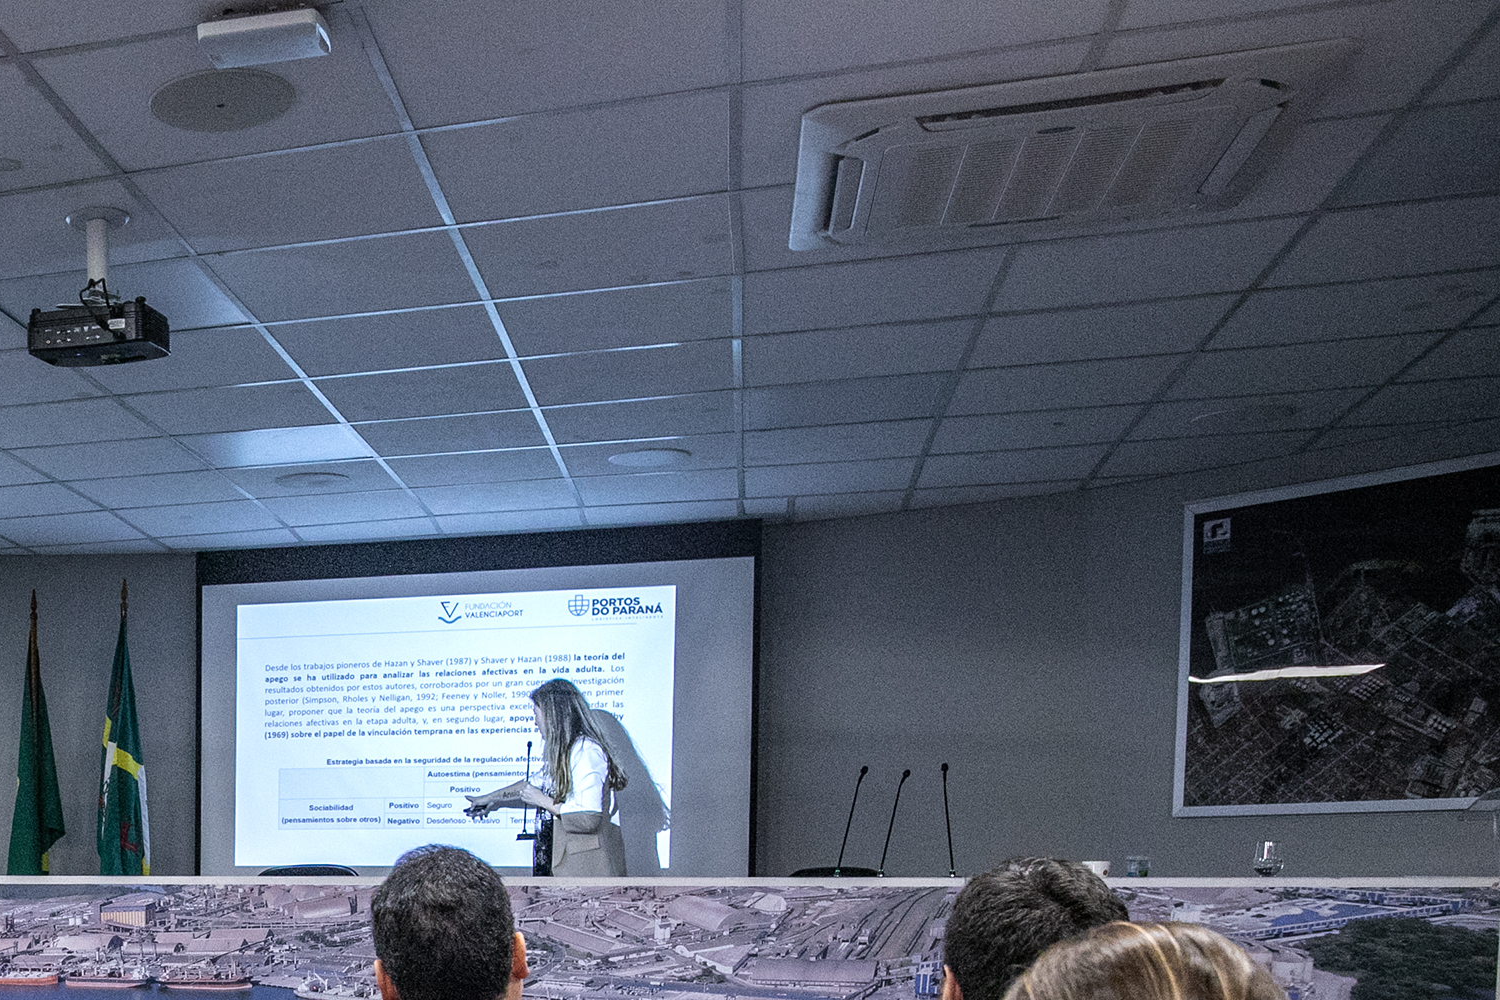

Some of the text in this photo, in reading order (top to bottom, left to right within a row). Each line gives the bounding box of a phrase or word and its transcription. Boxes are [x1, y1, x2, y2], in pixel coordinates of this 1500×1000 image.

[465, 601, 512, 610] FUNDACIÓN
[592, 597, 640, 606] PORTOS
[465, 610, 524, 618] VALENCIAPORT
[592, 602, 663, 616] DO PARANÁ
[265, 664, 288, 672] Desde
[304, 662, 334, 672] trabajos
[336, 661, 370, 671] pioneros
[384, 660, 408, 668] Hazan
[446, 657, 471, 666] (1987)
[481, 657, 507, 665] Shaver
[584, 653, 609, 661] teoría
[612, 652, 625, 660] del
[360, 674, 378, 682] para
[436, 669, 476, 677] relaciones
[482, 668, 518, 676] afectivas
[575, 665, 605, 673] adulta.
[265, 686, 304, 694] resultados
[306, 685, 344, 693] obtenidos
[385, 683, 417, 691] autores,
[420, 681, 473, 689] corroborados
[476, 681, 489, 689] por
[505, 680, 523, 688] gran
[571, 676, 624, 686] investigación
[265, 697, 299, 706] posterior
[302, 696, 339, 705] (Simpson,
[343, 695, 368, 703] Rholes
[379, 694, 412, 702] Nelligan,
[442, 693, 470, 701] Feeney
[482, 691, 507, 700] Noller,
[512, 691, 533, 699] 1990
[596, 689, 624, 697] primer
[265, 709, 285, 717] lugar,
[357, 706, 380, 714] teoría
[400, 706, 424, 714] apego
[460, 703, 505, 712] perspectiva
[265, 720, 302, 728] relaciones
[306, 719, 339, 727] afectivas
[366, 718, 388, 726] etapa
[392, 717, 418, 725] adulta,
[446, 715, 480, 723] segundo
[484, 714, 505, 723] lugar,
[265, 731, 289, 739] (1969)
[291, 730, 312, 738] sobre
[323, 730, 344, 738] papel
[368, 728, 412, 736] vinculación
[414, 728, 452, 736] temprana
[481, 726, 532, 735] experiencias
[327, 758, 363, 766] Estrategia
[414, 757, 451, 765] seguridad
[473, 756, 513, 764] regulación
[282, 816, 334, 824] (pensamientos
[359, 816, 381, 824] otros)
